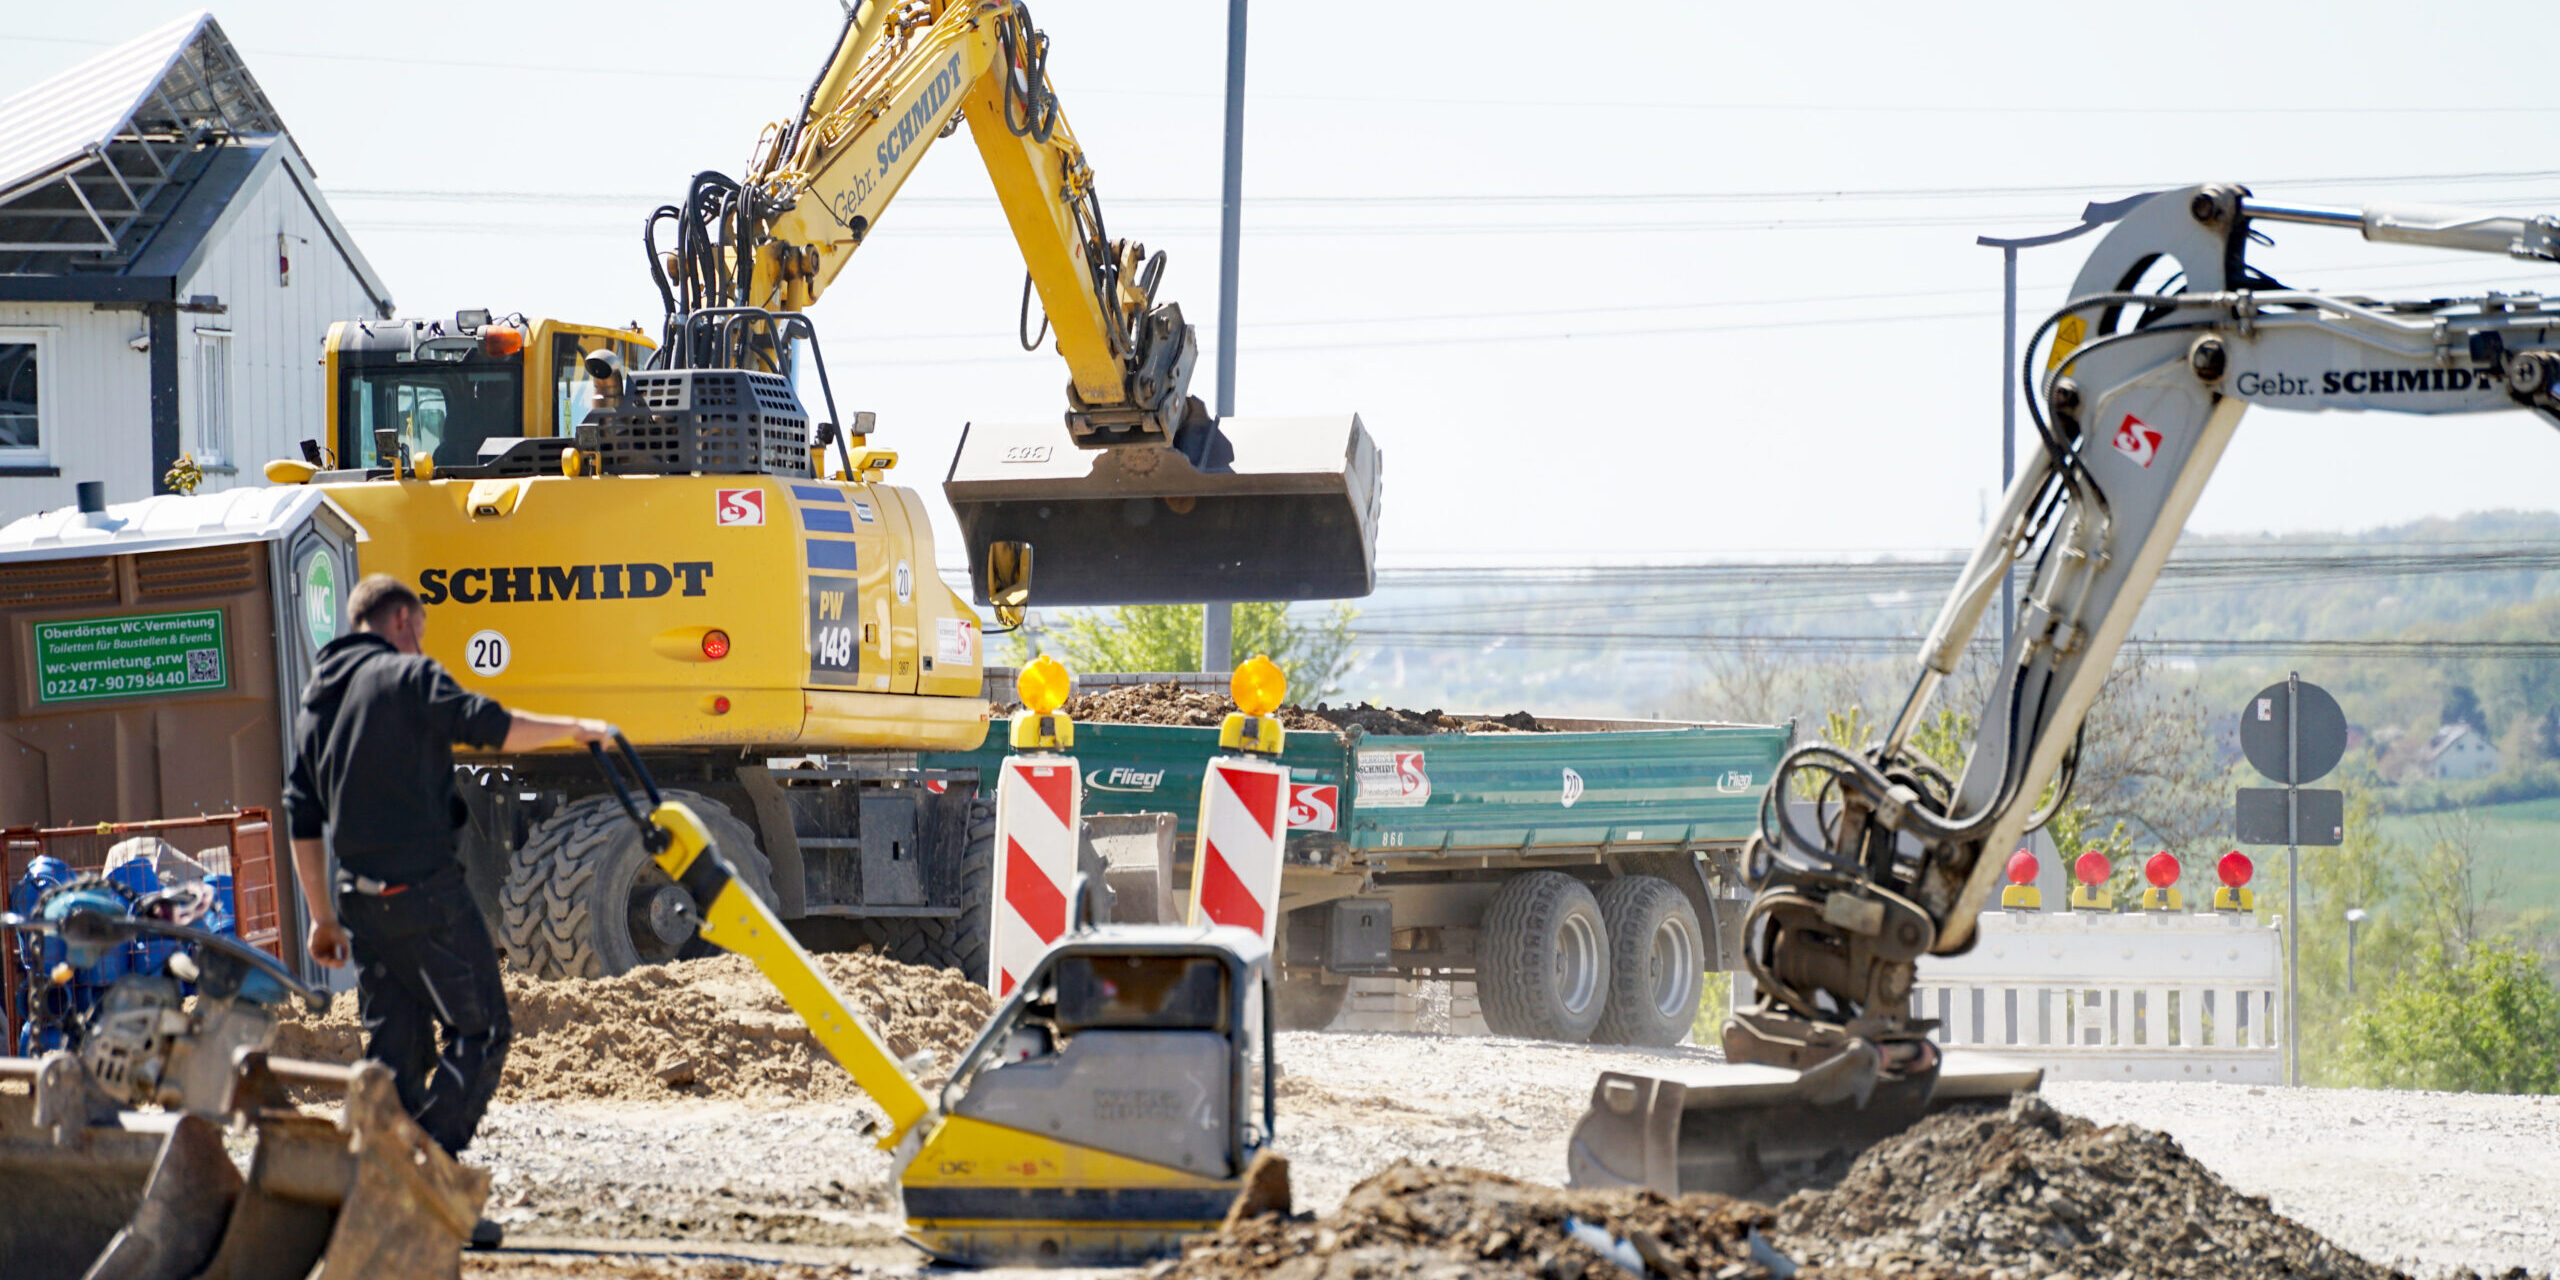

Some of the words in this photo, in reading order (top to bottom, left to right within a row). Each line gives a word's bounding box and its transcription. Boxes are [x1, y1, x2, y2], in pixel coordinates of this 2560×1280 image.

[833, 167, 877, 228] Gebr.
[877, 51, 962, 178] SCHMIDT
[2236, 370, 2315, 397] Gebr.
[2322, 368, 2497, 395] SCHMIDT
[419, 561, 713, 605] SCHMIDT
[898, 568, 909, 596] 20
[309, 584, 332, 624] WC
[818, 590, 845, 621] PW
[43, 625, 119, 640] Oberdörster
[121, 618, 215, 633] WC-Vermietung
[49, 641, 94, 654] Toiletten
[96, 639, 111, 651] für
[113, 635, 168, 650] Baustellen
[170, 633, 178, 645] &
[179, 633, 212, 645] Events
[474, 639, 501, 668] 20
[818, 625, 851, 667] 148
[46, 654, 184, 675] wc-vermietung.nrw
[1108, 767, 1165, 789] Fliegl
[1360, 765, 1395, 774] SCHMIDT
[1566, 773, 1580, 799] 20
[1382, 831, 1403, 847] 860
